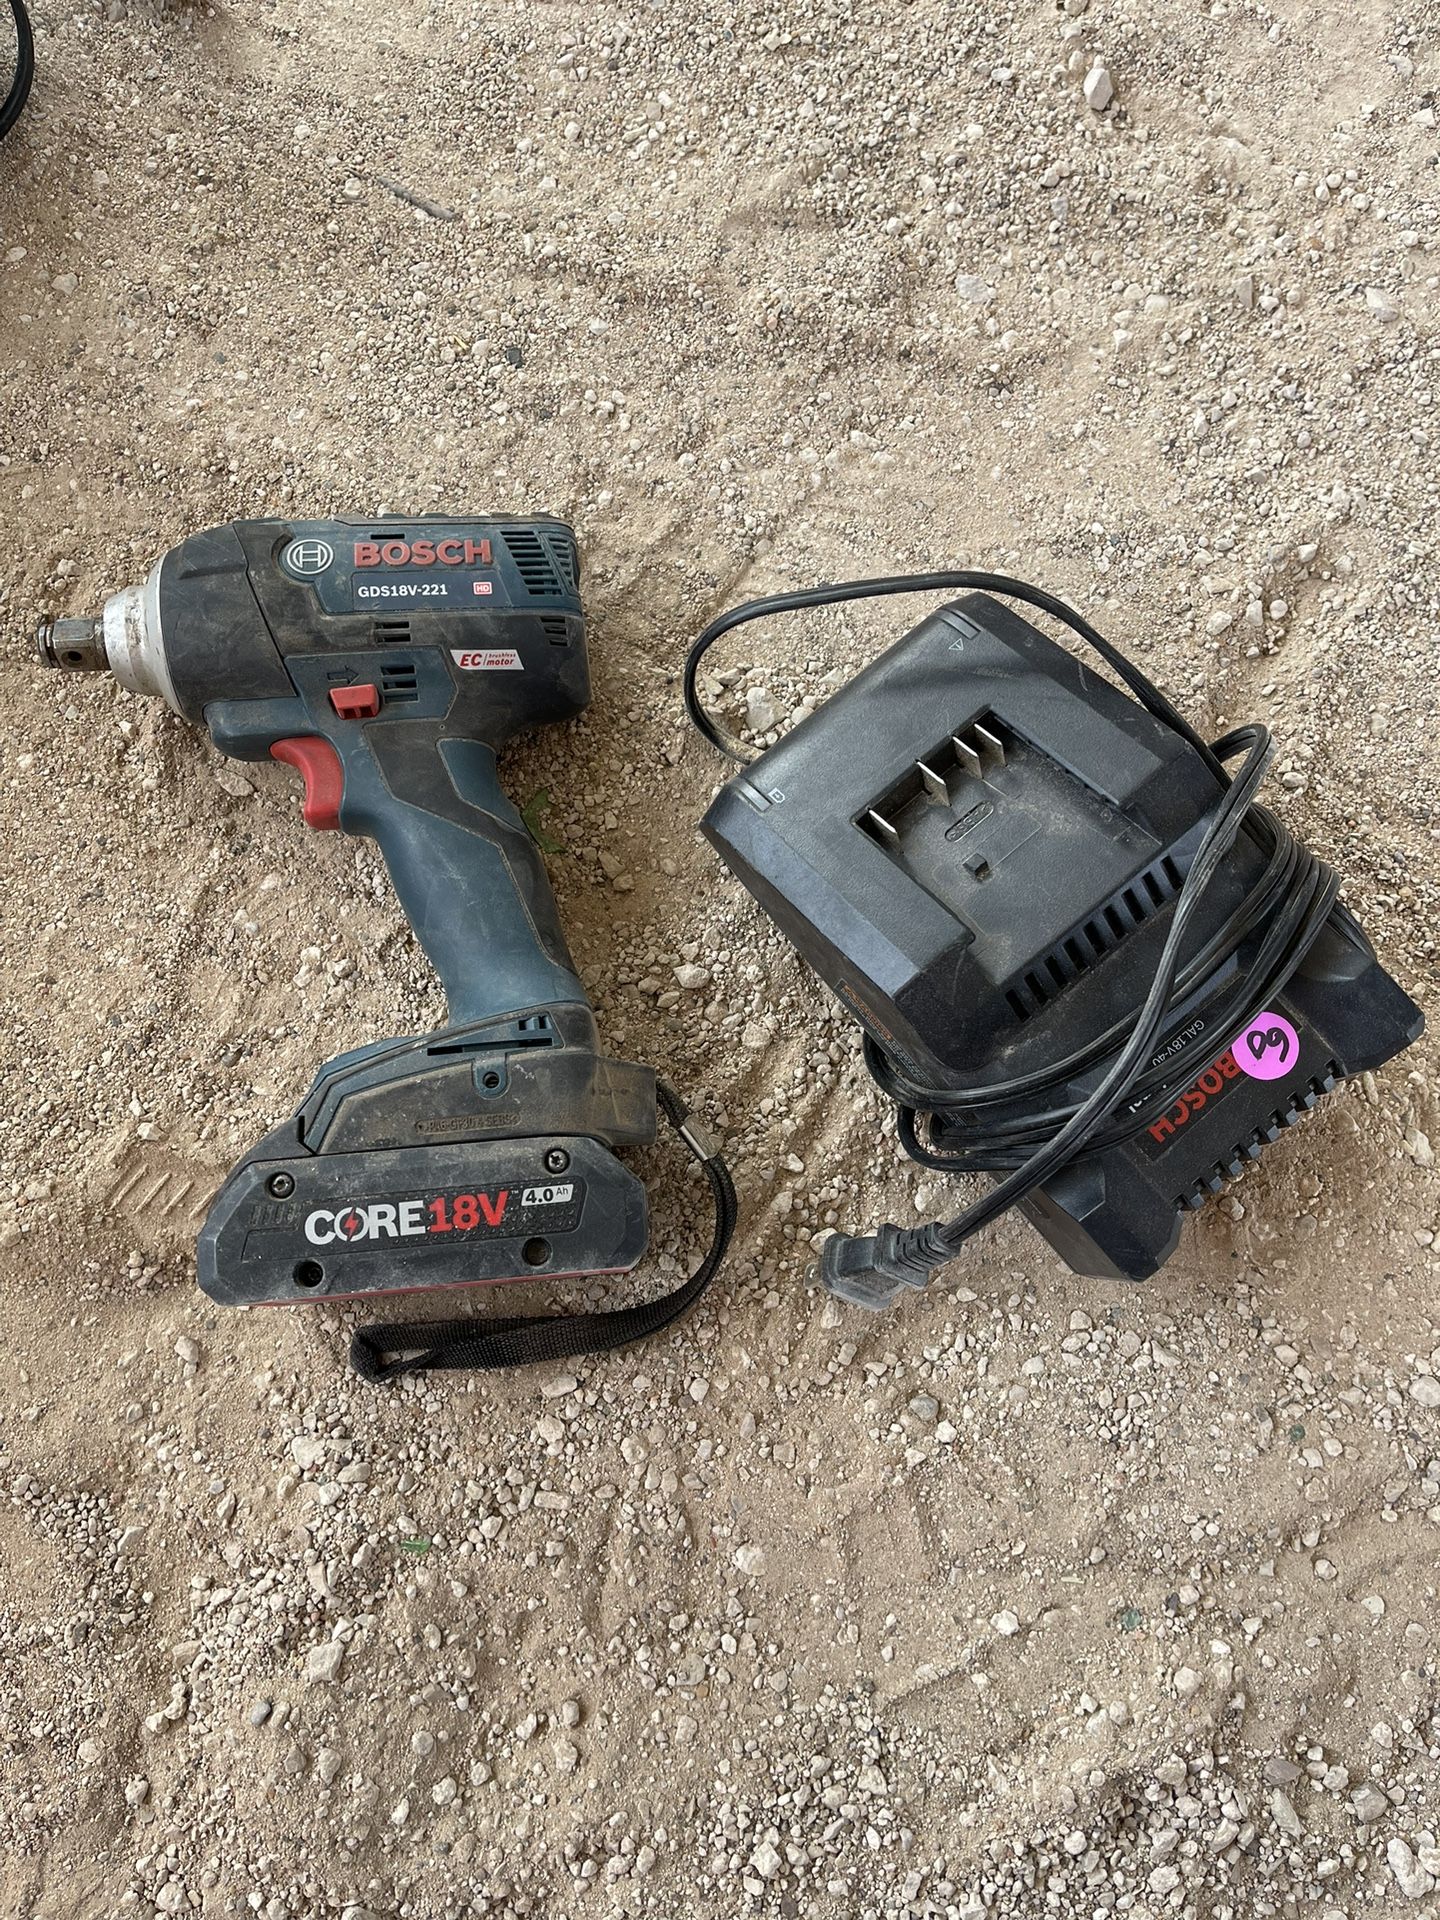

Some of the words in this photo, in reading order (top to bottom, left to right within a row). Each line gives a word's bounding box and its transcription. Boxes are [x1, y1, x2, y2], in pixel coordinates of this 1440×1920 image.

[353, 539, 493, 568] BOSCH
[358, 584, 448, 598] GDS18V-221
[475, 584, 490, 593] HD
[460, 653, 482, 667] EC
[486, 658, 514, 666] motor
[488, 651, 516, 659] brushless
[1149, 1049, 1242, 1143] BOSCH
[525, 1188, 554, 1204] 4.0
[555, 1186, 570, 1197] Ah
